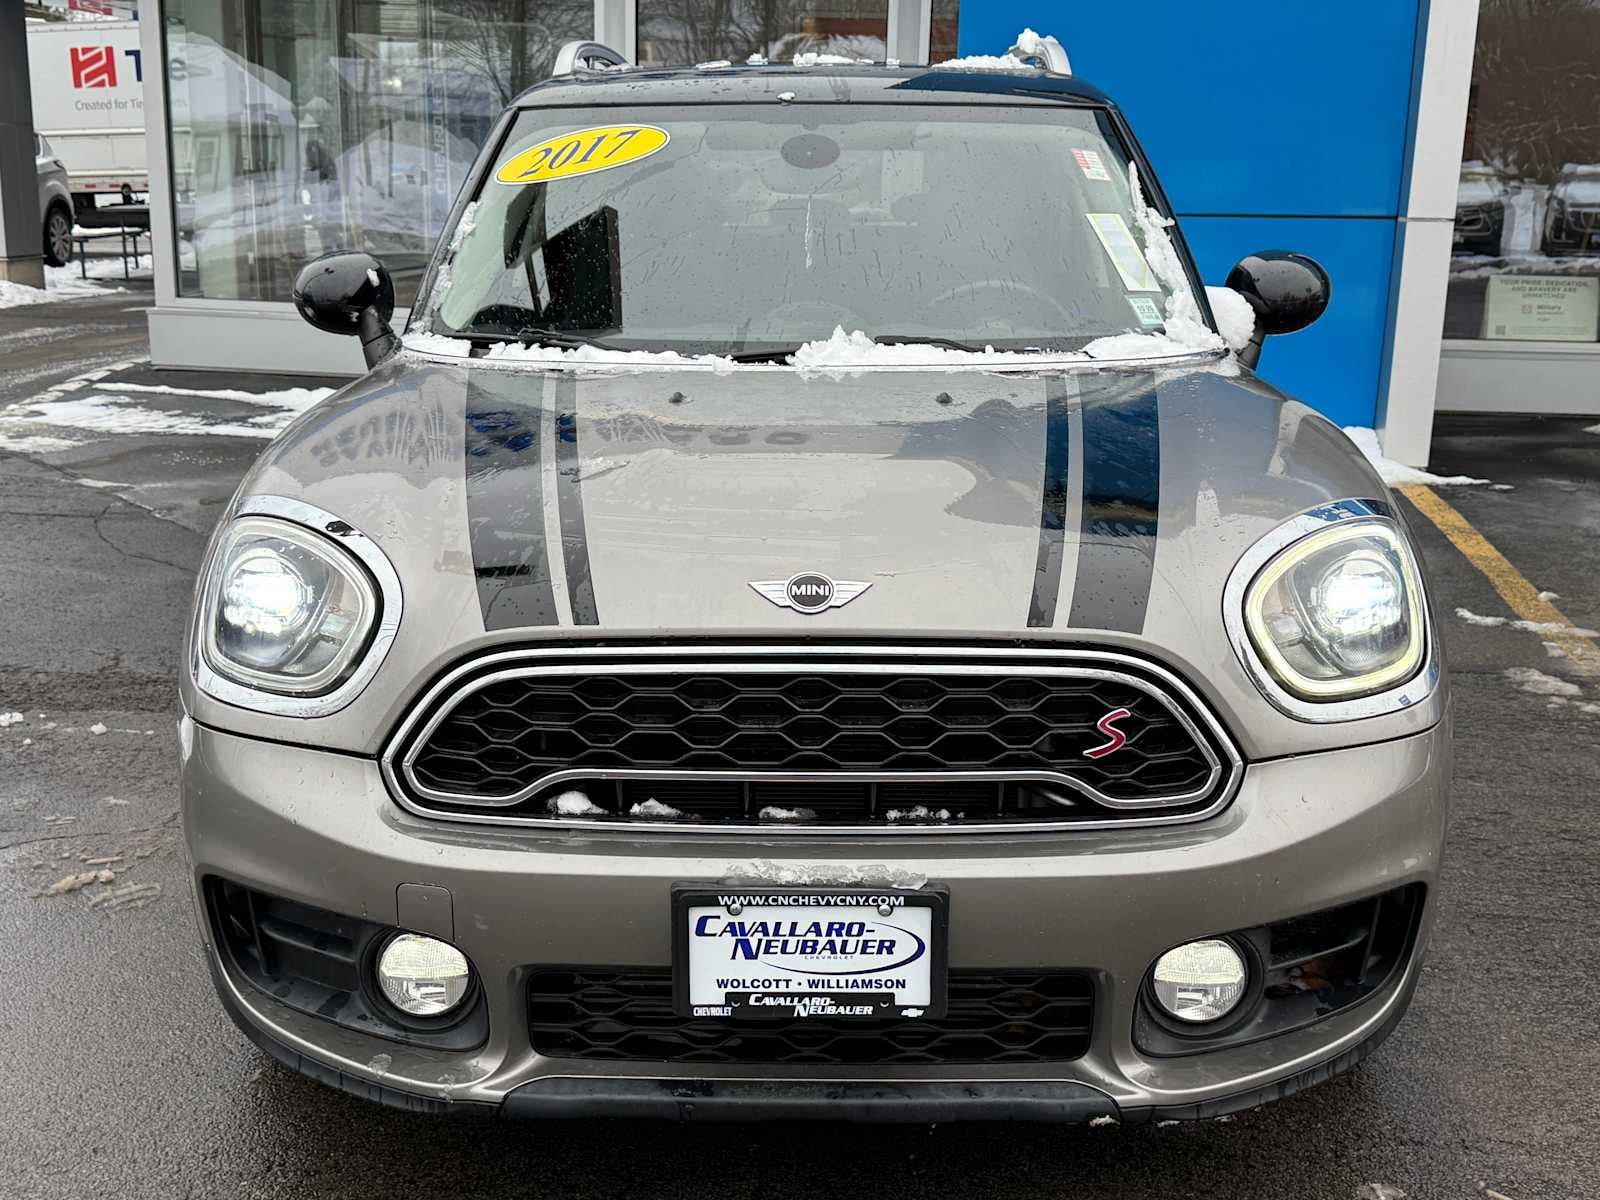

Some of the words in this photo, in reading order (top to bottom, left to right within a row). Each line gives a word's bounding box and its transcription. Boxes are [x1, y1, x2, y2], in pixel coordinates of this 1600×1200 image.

[74, 99, 112, 111] Created
[114, 98, 128, 110] for
[517, 129, 641, 178] 2017
[791, 584, 830, 596] MINI
[1082, 708, 1131, 759] S
[718, 895, 905, 906] WWW.CNCHEVYCNY.COM
[730, 938, 896, 961] NEUBAUER
[716, 978, 793, 989] WOLCOTT
[807, 978, 906, 989] WILLIAMSON
[693, 1007, 732, 1017] CHEVROLET
[793, 1004, 874, 1018] NEUBAUER
